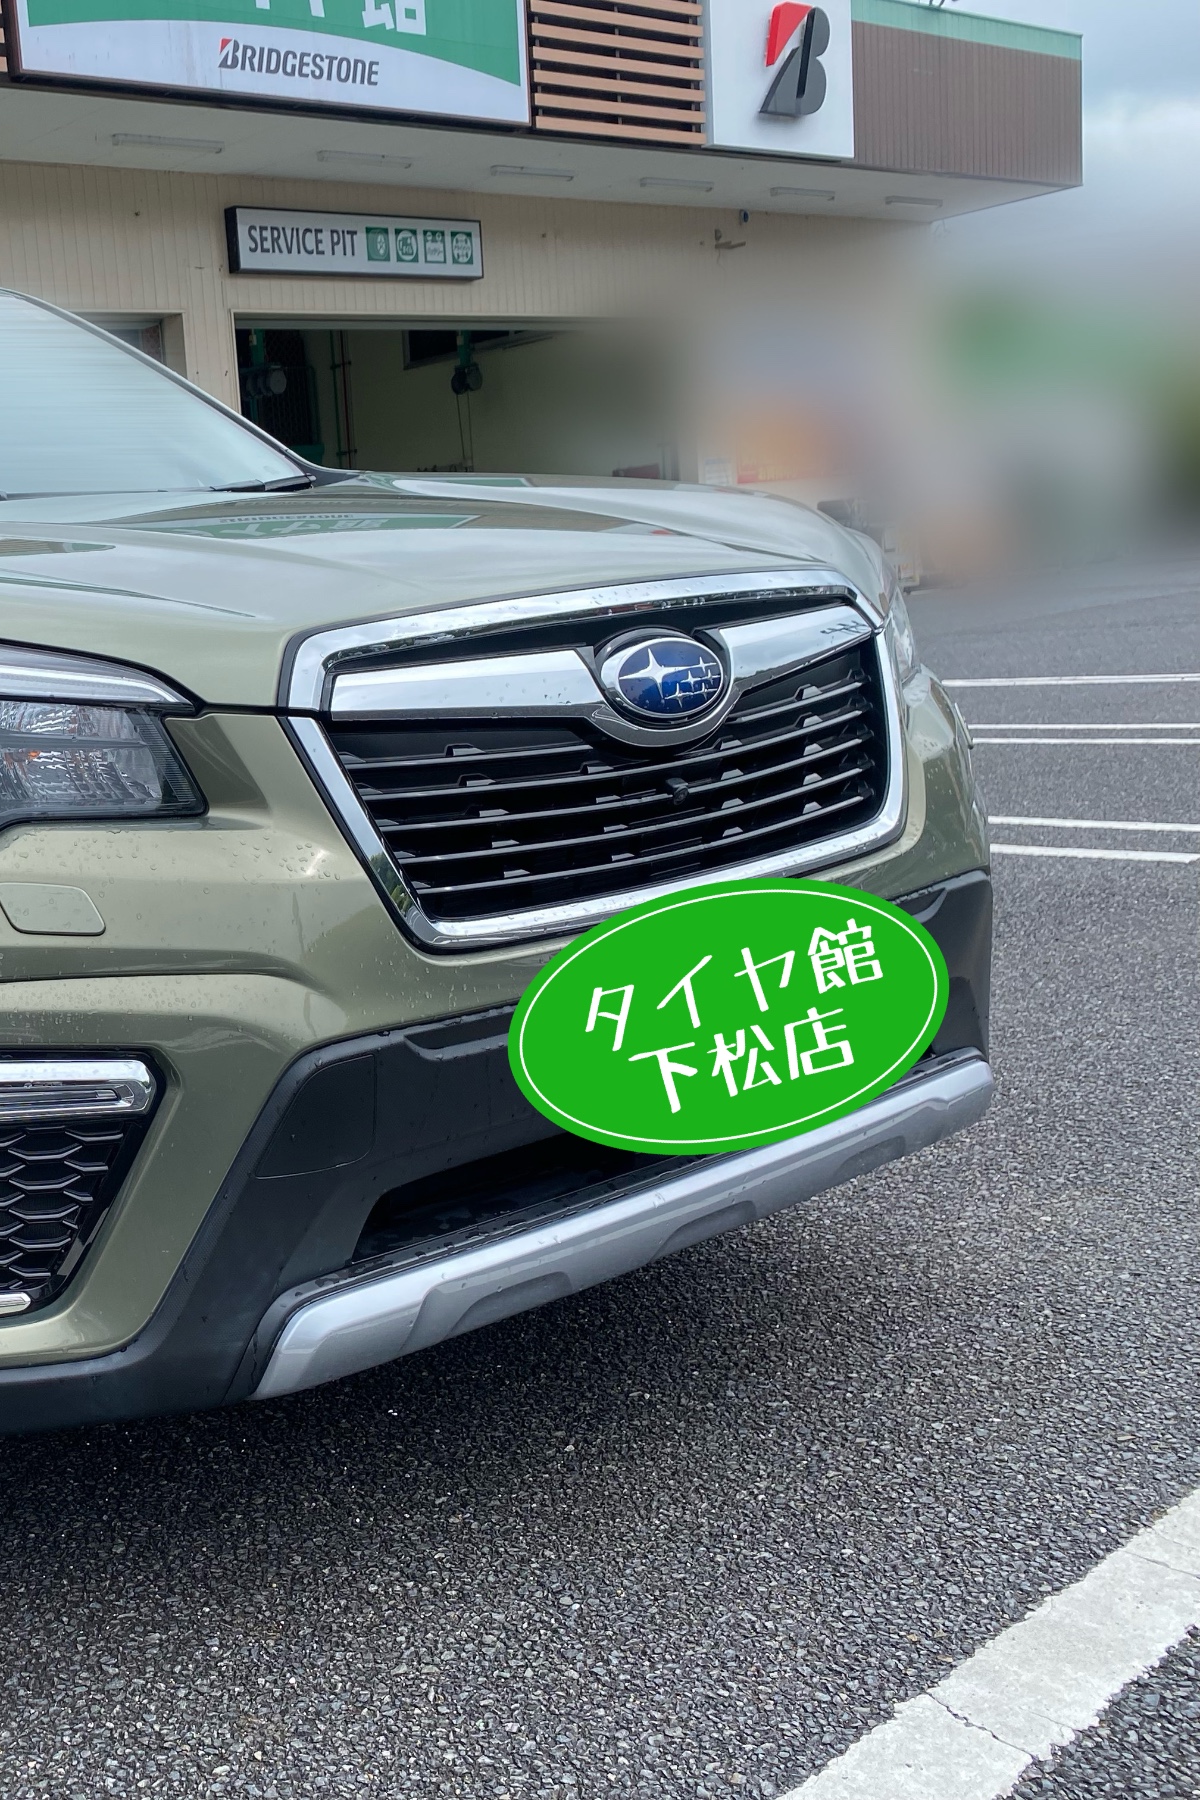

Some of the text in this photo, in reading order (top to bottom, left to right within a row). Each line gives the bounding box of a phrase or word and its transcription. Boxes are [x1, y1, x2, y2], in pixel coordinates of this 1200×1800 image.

[218, 38, 379, 86] BRIDGESTONE
[248, 224, 358, 257] SERVICE PIT
